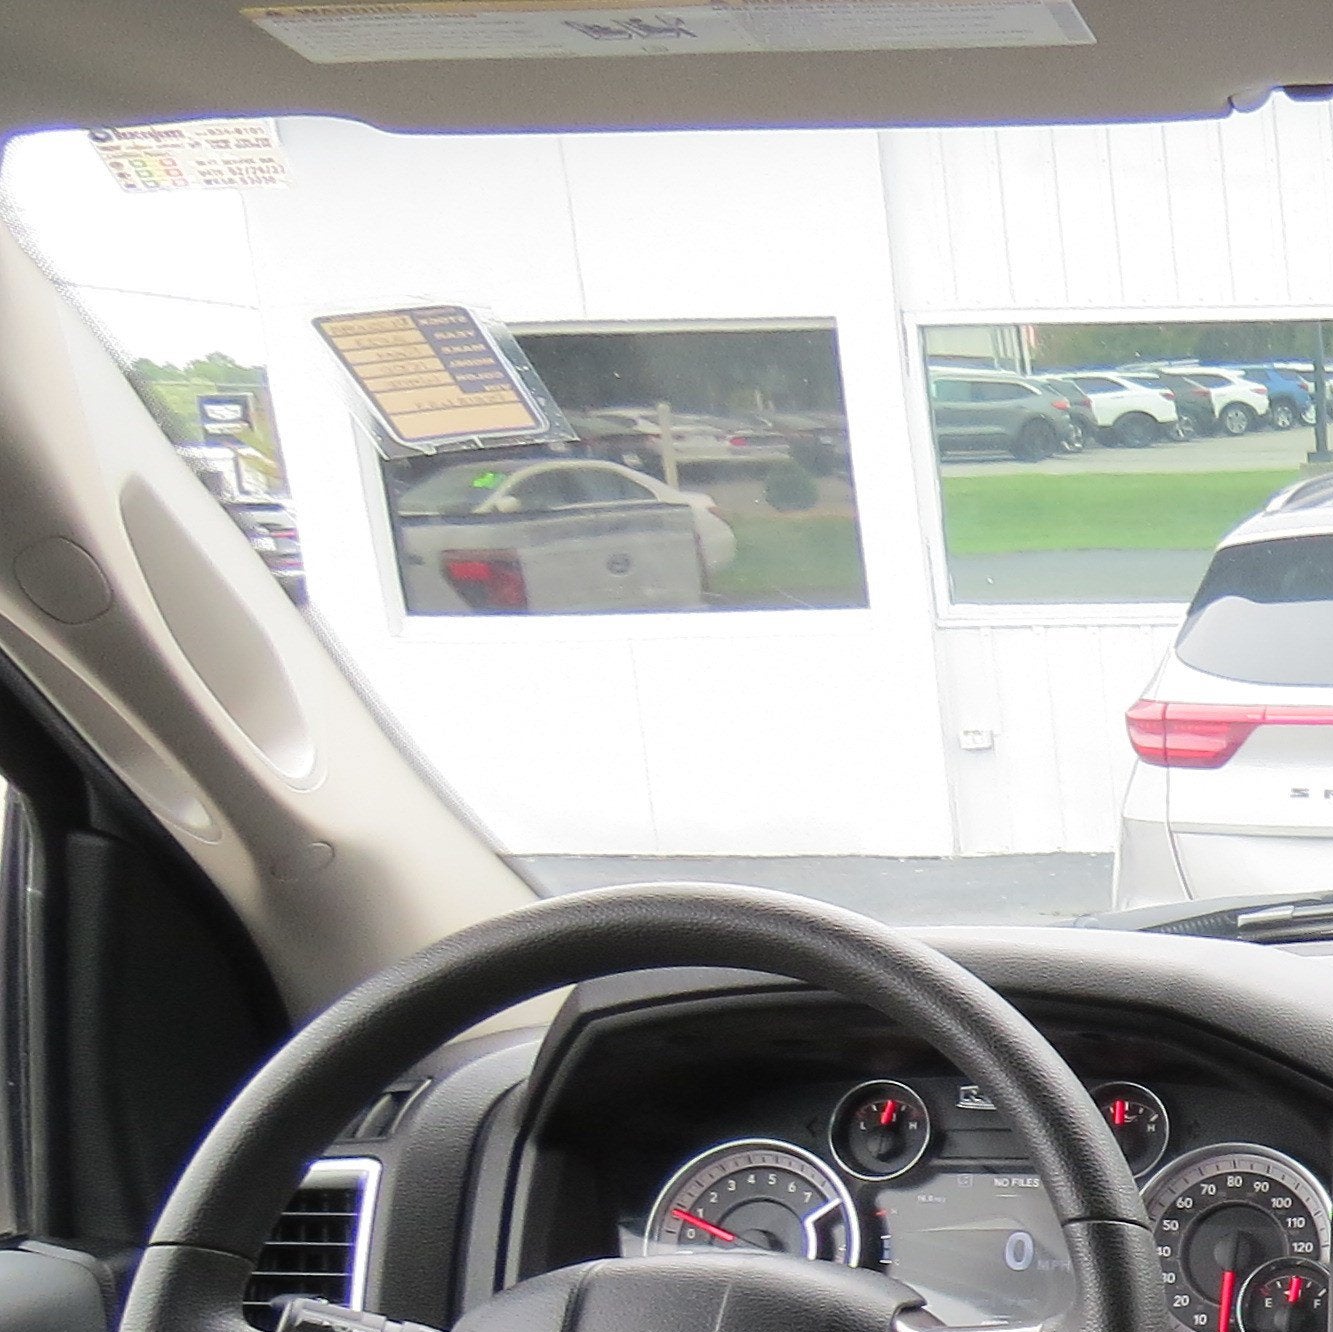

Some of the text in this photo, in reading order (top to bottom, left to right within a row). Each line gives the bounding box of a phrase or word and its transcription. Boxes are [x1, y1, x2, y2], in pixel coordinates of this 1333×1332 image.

[747, 1174, 756, 1184] 4
[769, 1174, 777, 1185] 5
[994, 1178, 1041, 1188] NO FILES
[1226, 1176, 1243, 1187] 80
[728, 1180, 736, 1191] 3
[788, 1182, 796, 1192] 6
[1201, 1184, 1216, 1195] 70
[1253, 1181, 1269, 1193] 90
[710, 1192, 718, 1203] 2
[804, 1192, 812, 1203] 7
[1177, 1197, 1193, 1209] 60
[1271, 1197, 1292, 1208] 100
[697, 1208, 704, 1218] 1
[1163, 1220, 1179, 1231] 50
[1286, 1217, 1306, 1228] 110
[687, 1229, 695, 1239] 0
[1005, 1231, 1034, 1271] 0
[1292, 1242, 1314, 1253] 120
[1173, 1295, 1189, 1307] 20
[1265, 1299, 1273, 1308] E
[1314, 1299, 1322, 1309] F
[1194, 1314, 1207, 1325] 10
